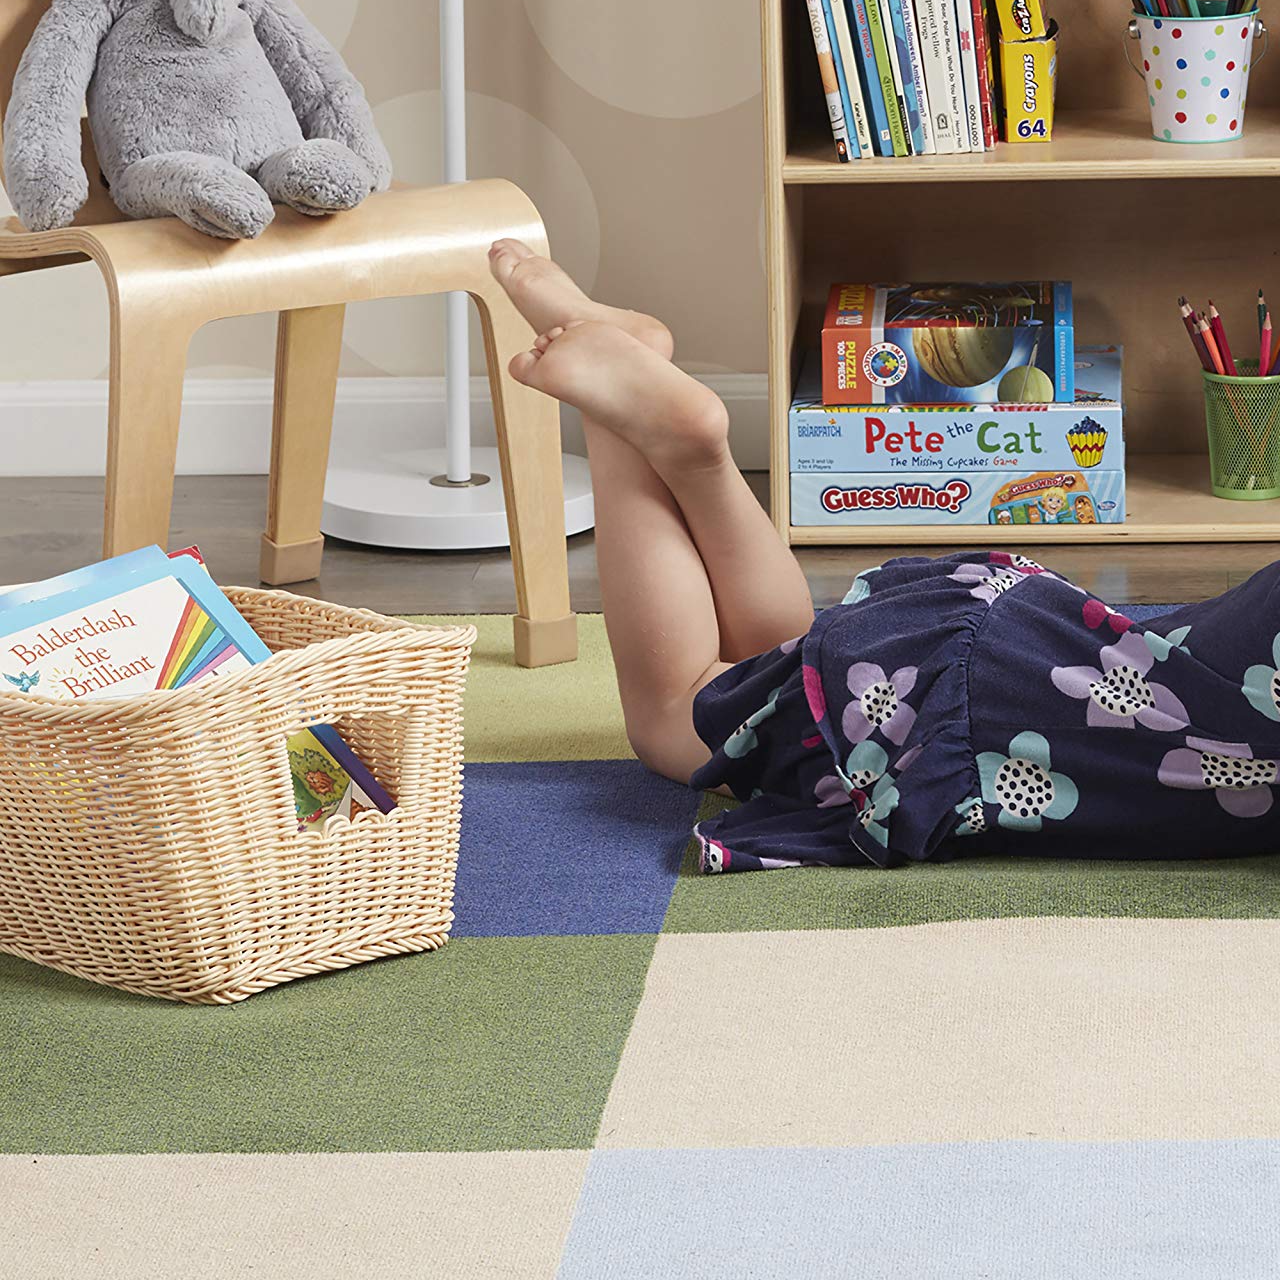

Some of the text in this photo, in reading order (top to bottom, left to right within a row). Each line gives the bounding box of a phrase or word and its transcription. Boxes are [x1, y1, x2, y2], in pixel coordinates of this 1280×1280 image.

[903, 10, 911, 20] It's
[939, 3, 948, 19] Bear,
[855, 3, 865, 25] DUMP
[860, 27, 872, 58] TRUCKS
[919, 16, 929, 40] Frogs
[942, 20, 950, 36] Polar
[903, 20, 918, 62] Halloween,
[930, 29, 941, 58] Yellow
[944, 38, 952, 54] Bear,
[809, 8, 823, 39] TACOS
[829, 104, 838, 117] Dial
[946, 55, 954, 71] What
[868, 3, 880, 25] Love
[884, 82, 898, 118] Random
[891, 119, 903, 148] House
[911, 63, 922, 88] Amber
[948, 73, 955, 84] Do
[1023, 53, 1039, 113] Crayons
[915, 89, 927, 117] Brown?
[951, 96, 959, 115] Hear?
[953, 119, 961, 136] Henry
[1017, 118, 1047, 138] 64
[837, 340, 846, 390] 100 PIECES
[846, 341, 856, 389] PUZZLE
[864, 346, 879, 383] COLLECTION
[890, 345, 906, 368] SMART
[864, 417, 1043, 454] Pete the Cat
[890, 456, 1018, 469] The Missing Cupcakes Game
[822, 480, 971, 512] Guess Who?
[1009, 474, 1065, 495] Guess Who?
[8, 608, 137, 666] Balderdash
[74, 646, 112, 668] the
[59, 654, 157, 698] Brilliant
